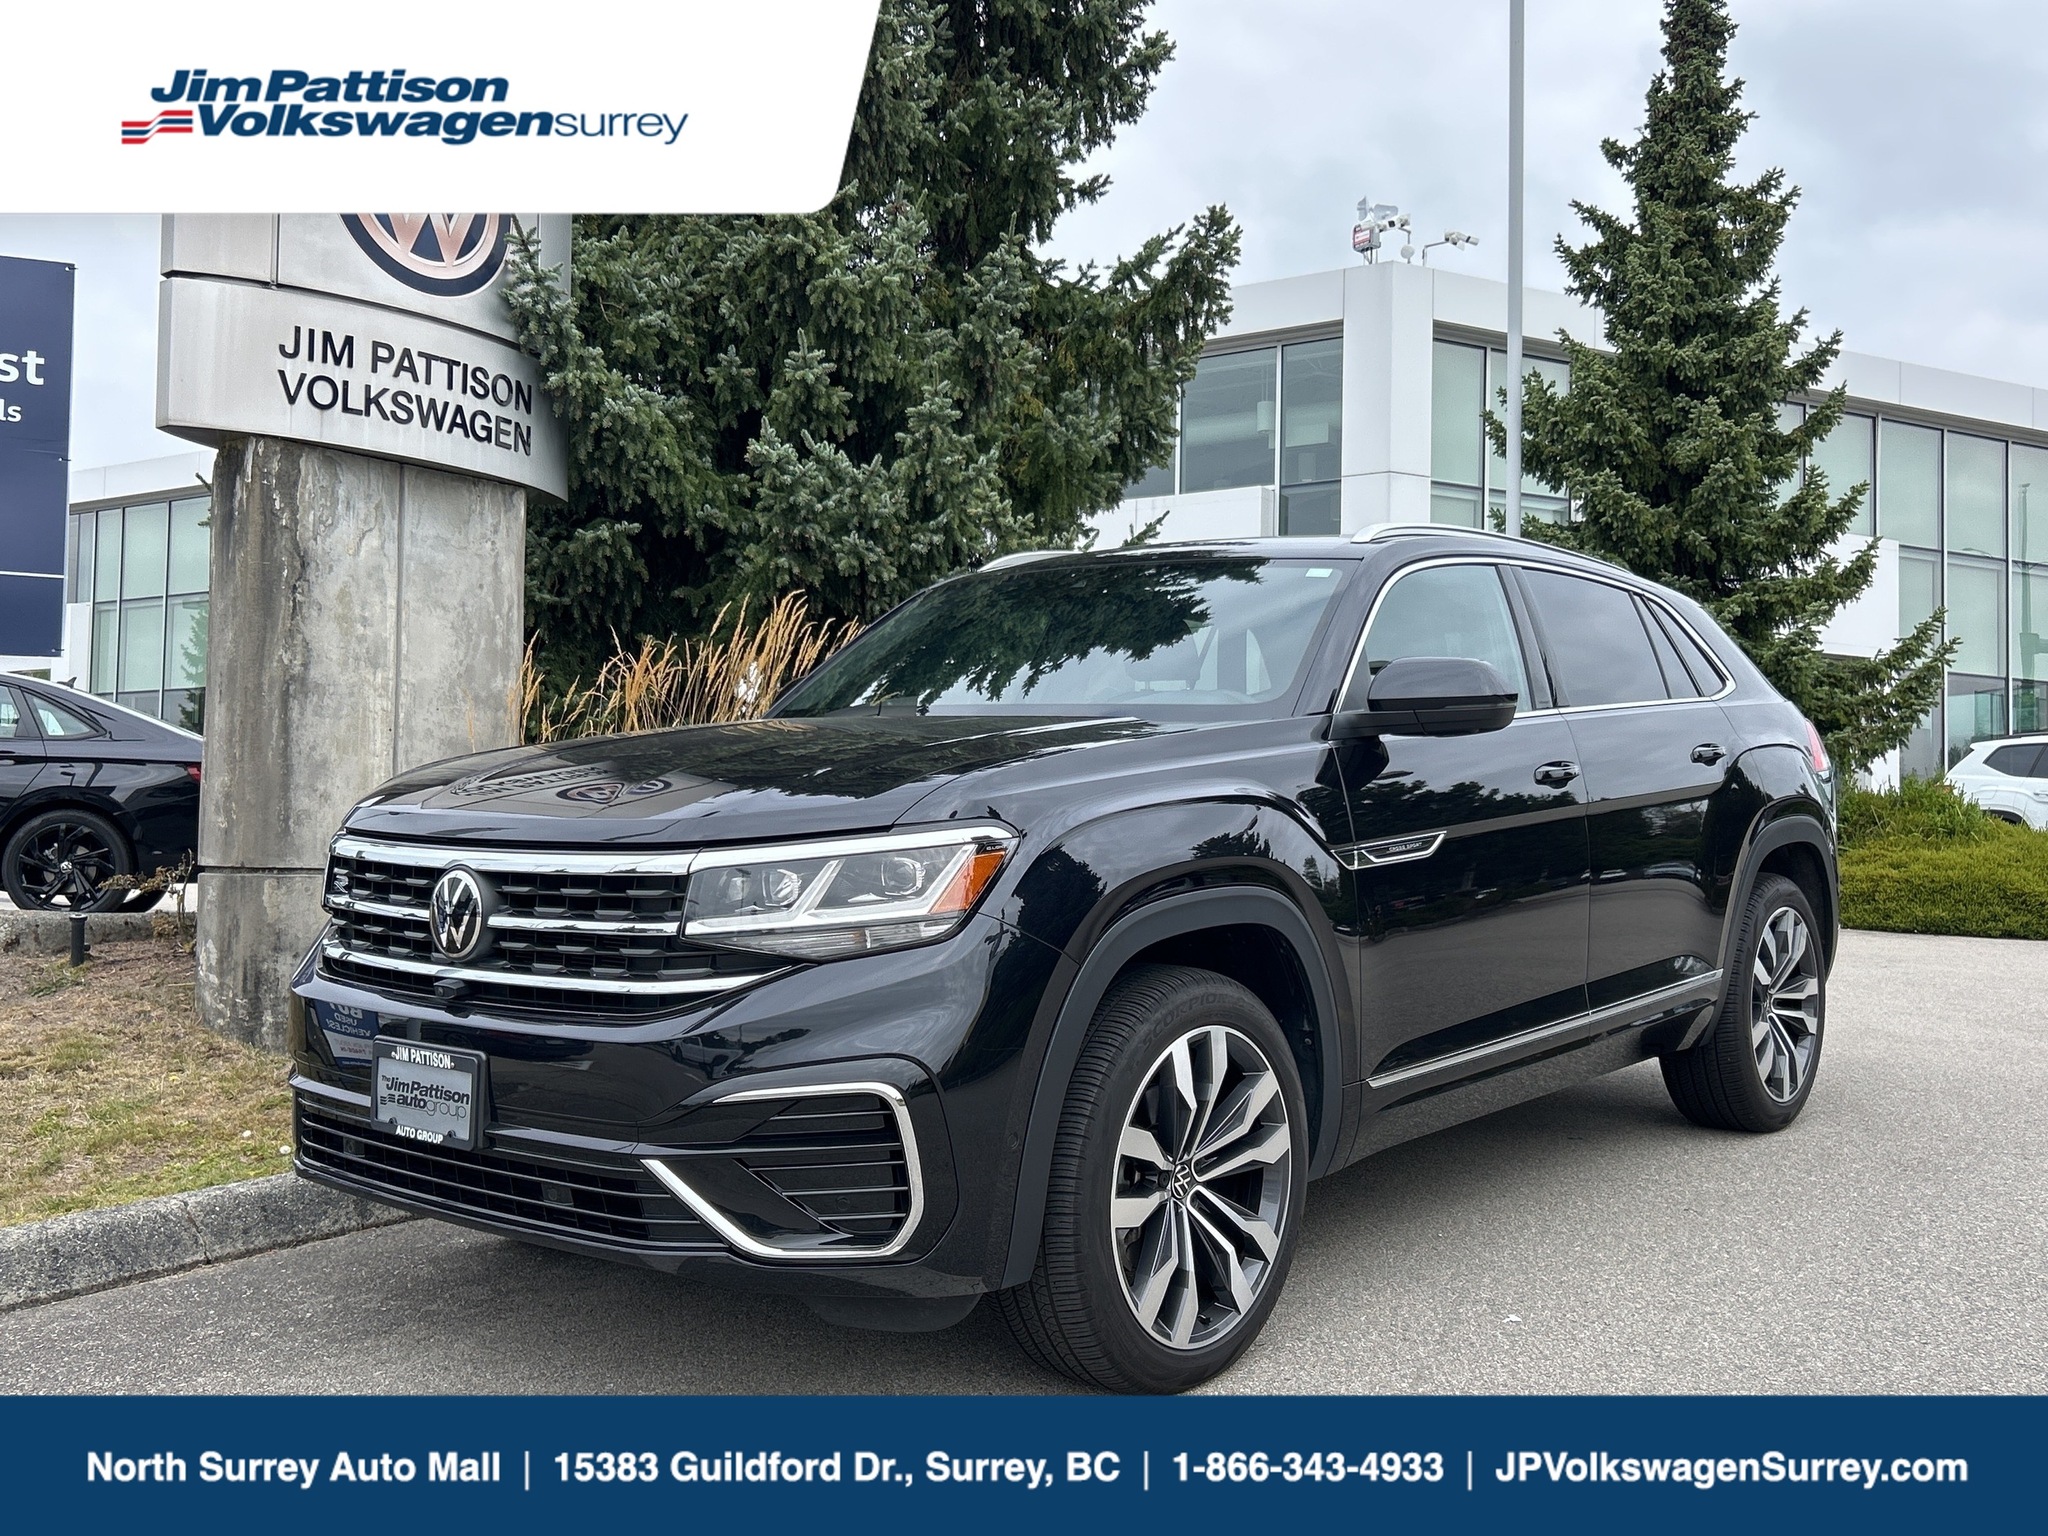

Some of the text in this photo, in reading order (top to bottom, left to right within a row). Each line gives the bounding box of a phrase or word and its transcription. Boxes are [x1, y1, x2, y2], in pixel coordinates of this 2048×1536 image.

[278, 325, 532, 415] JIM PATTISON
[278, 369, 532, 456] VOLKSWAGEN
[395, 1046, 451, 1069] JIM PATTISON
[411, 1081, 470, 1105] Pattison
[395, 1125, 443, 1144] AUTO GROUP
